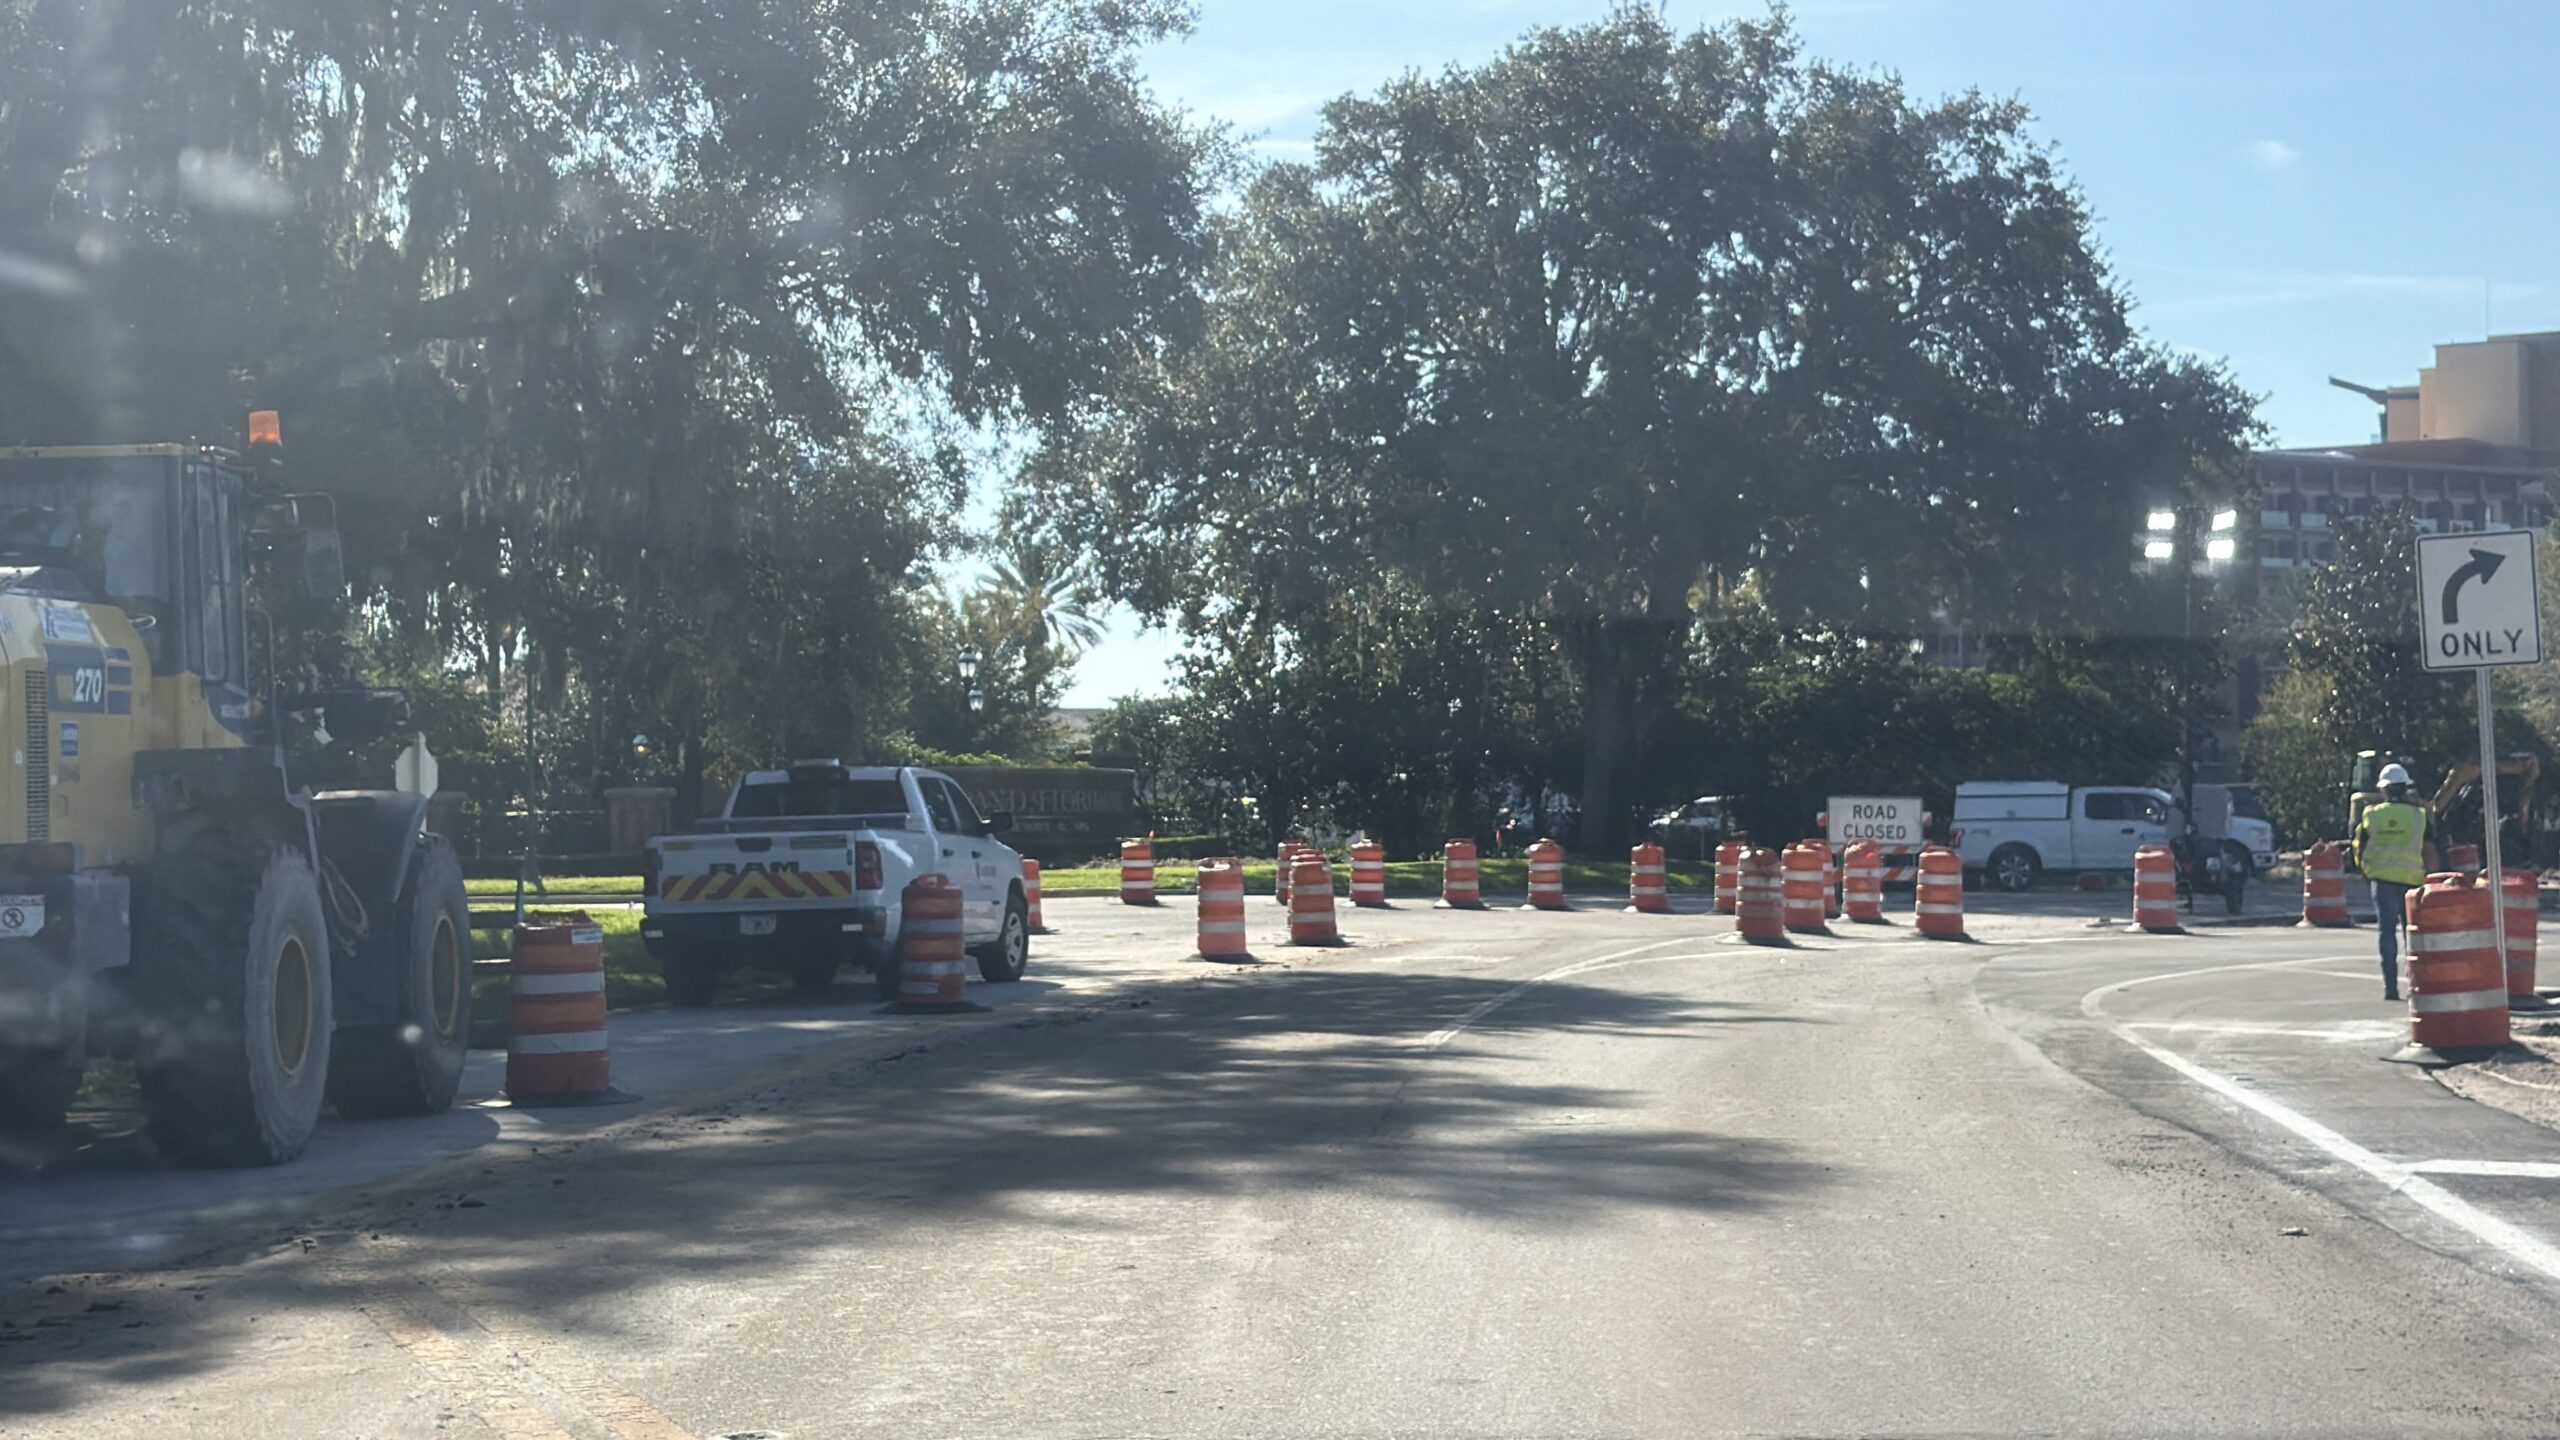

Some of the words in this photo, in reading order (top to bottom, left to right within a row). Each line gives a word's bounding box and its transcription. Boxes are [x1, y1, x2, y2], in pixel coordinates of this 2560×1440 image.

[2441, 629, 2523, 657] ONLY
[74, 667, 103, 703] 270
[1853, 805, 1897, 819] ROAD
[1843, 824, 1906, 839] CLOSED
[708, 861, 800, 875] RAM
